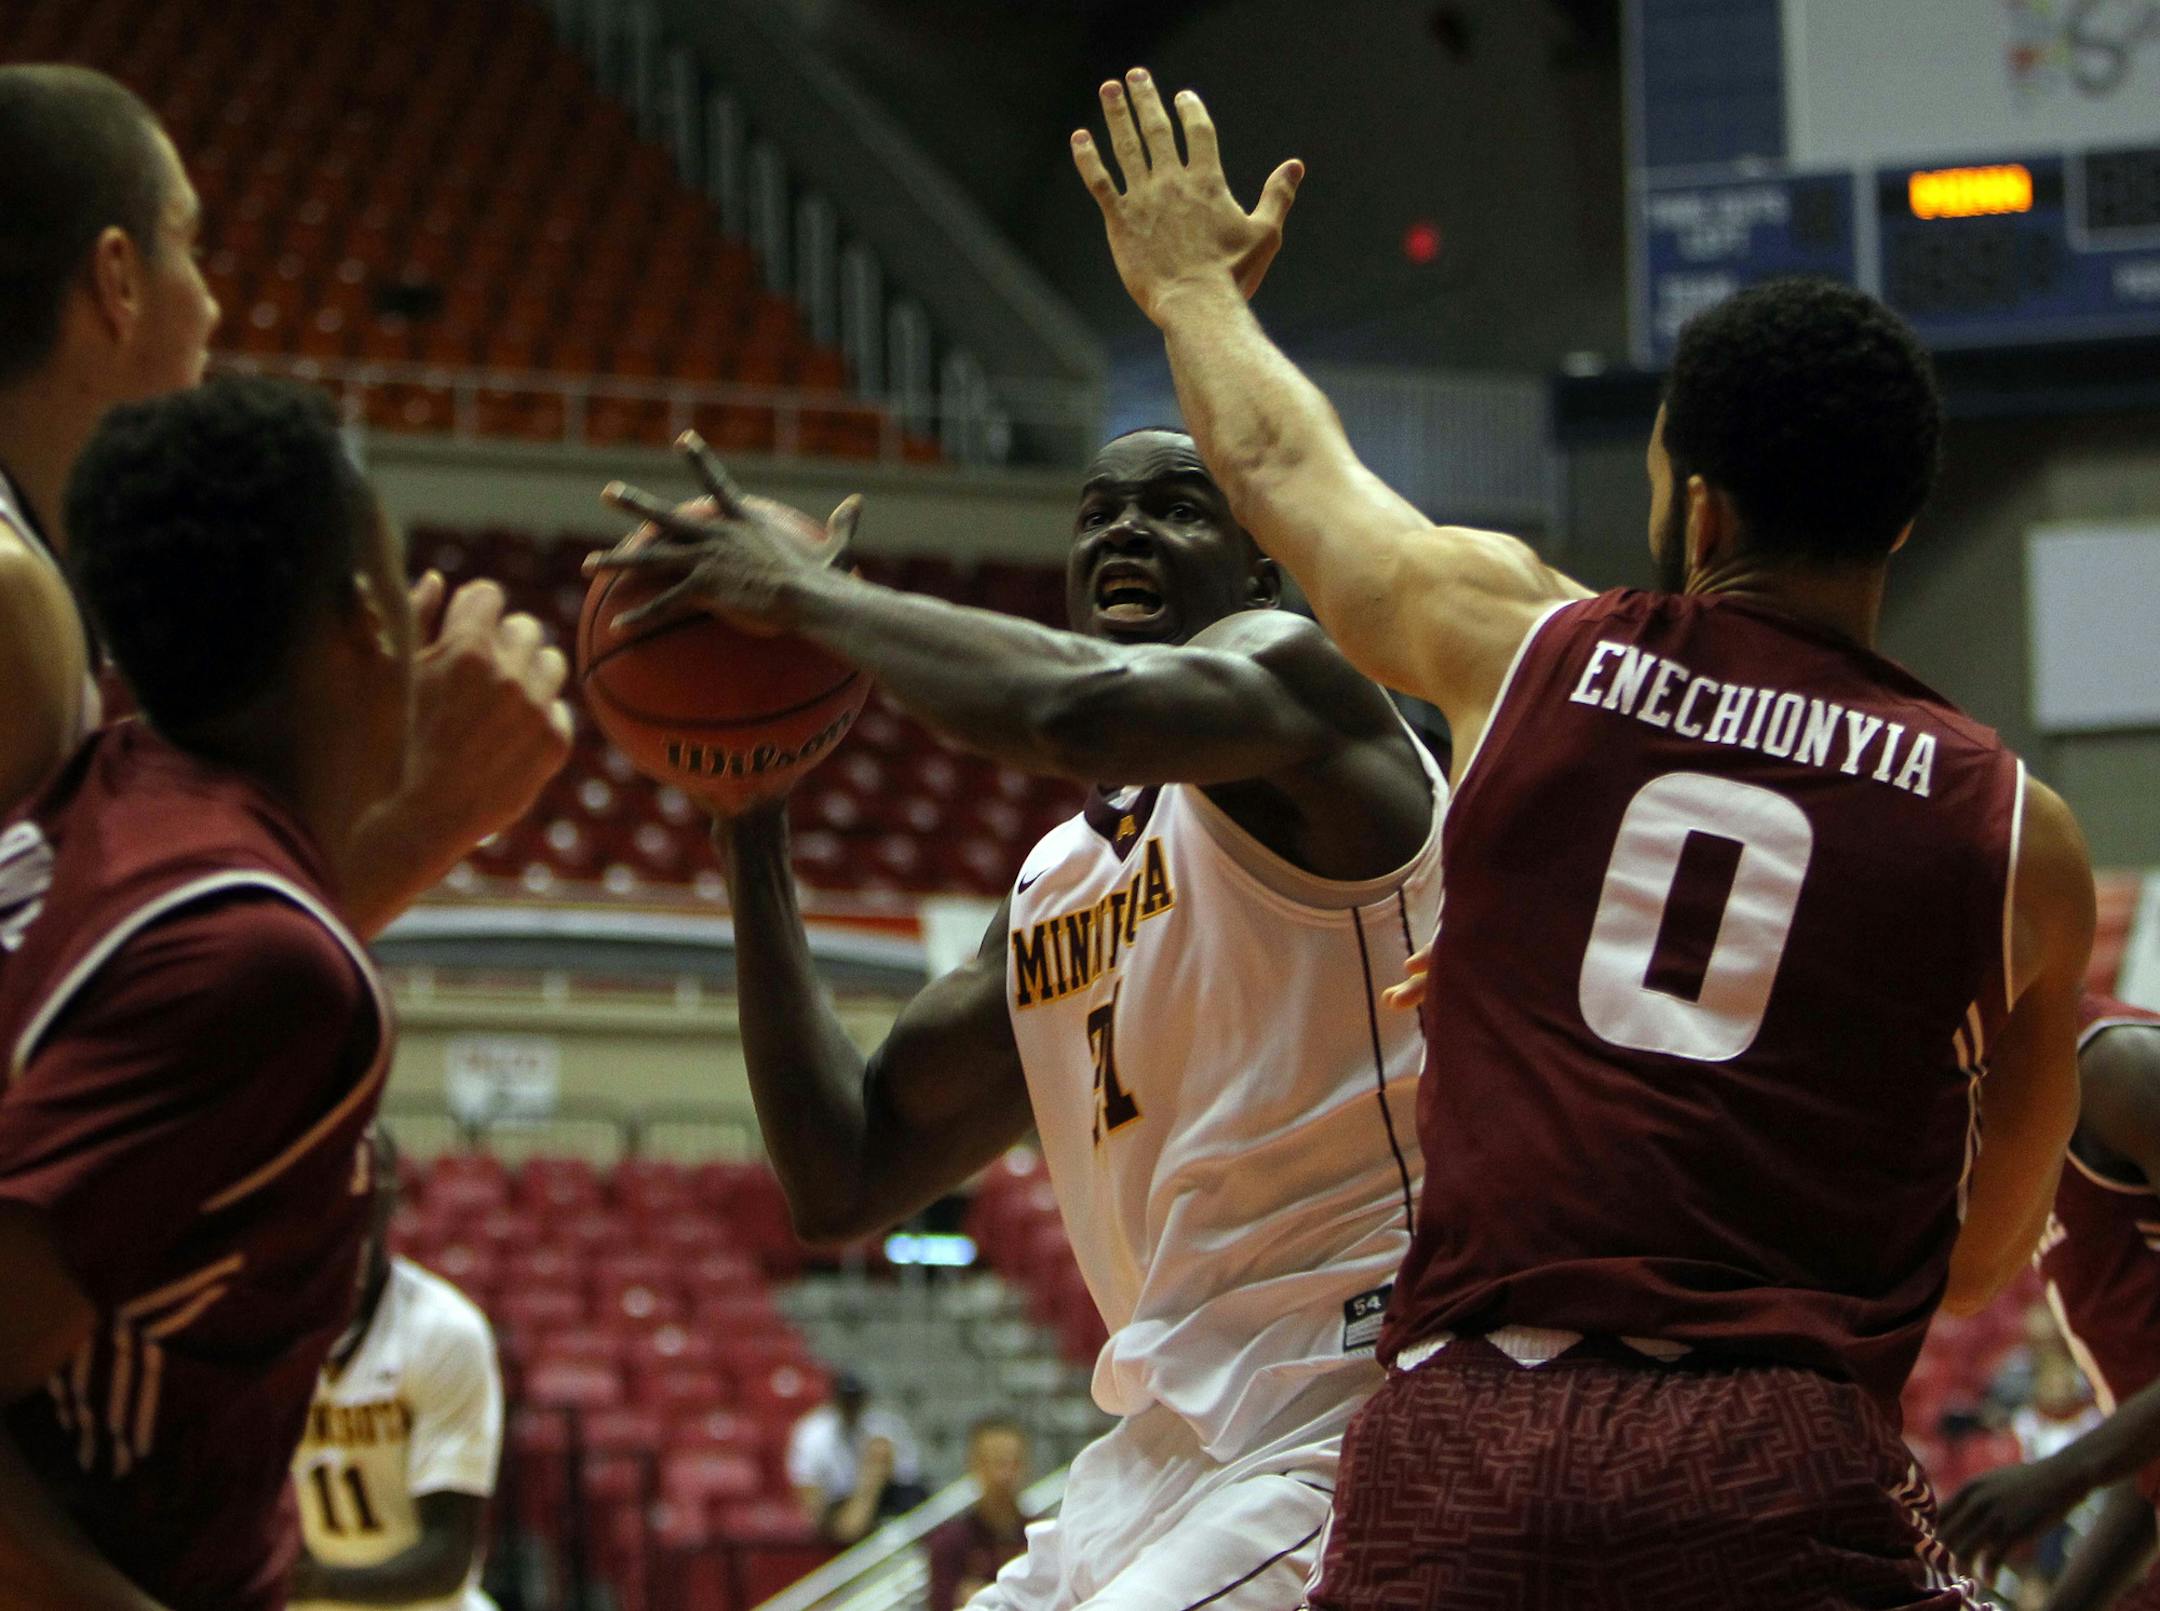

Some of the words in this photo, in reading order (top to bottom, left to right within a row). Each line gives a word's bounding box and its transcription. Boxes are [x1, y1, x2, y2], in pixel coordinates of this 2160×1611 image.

[1570, 640, 1937, 798] ENECHIONYIA
[1578, 771, 1813, 1063] 0
[1353, 1294, 1381, 1317] 54
[309, 1462, 385, 1536] 11
